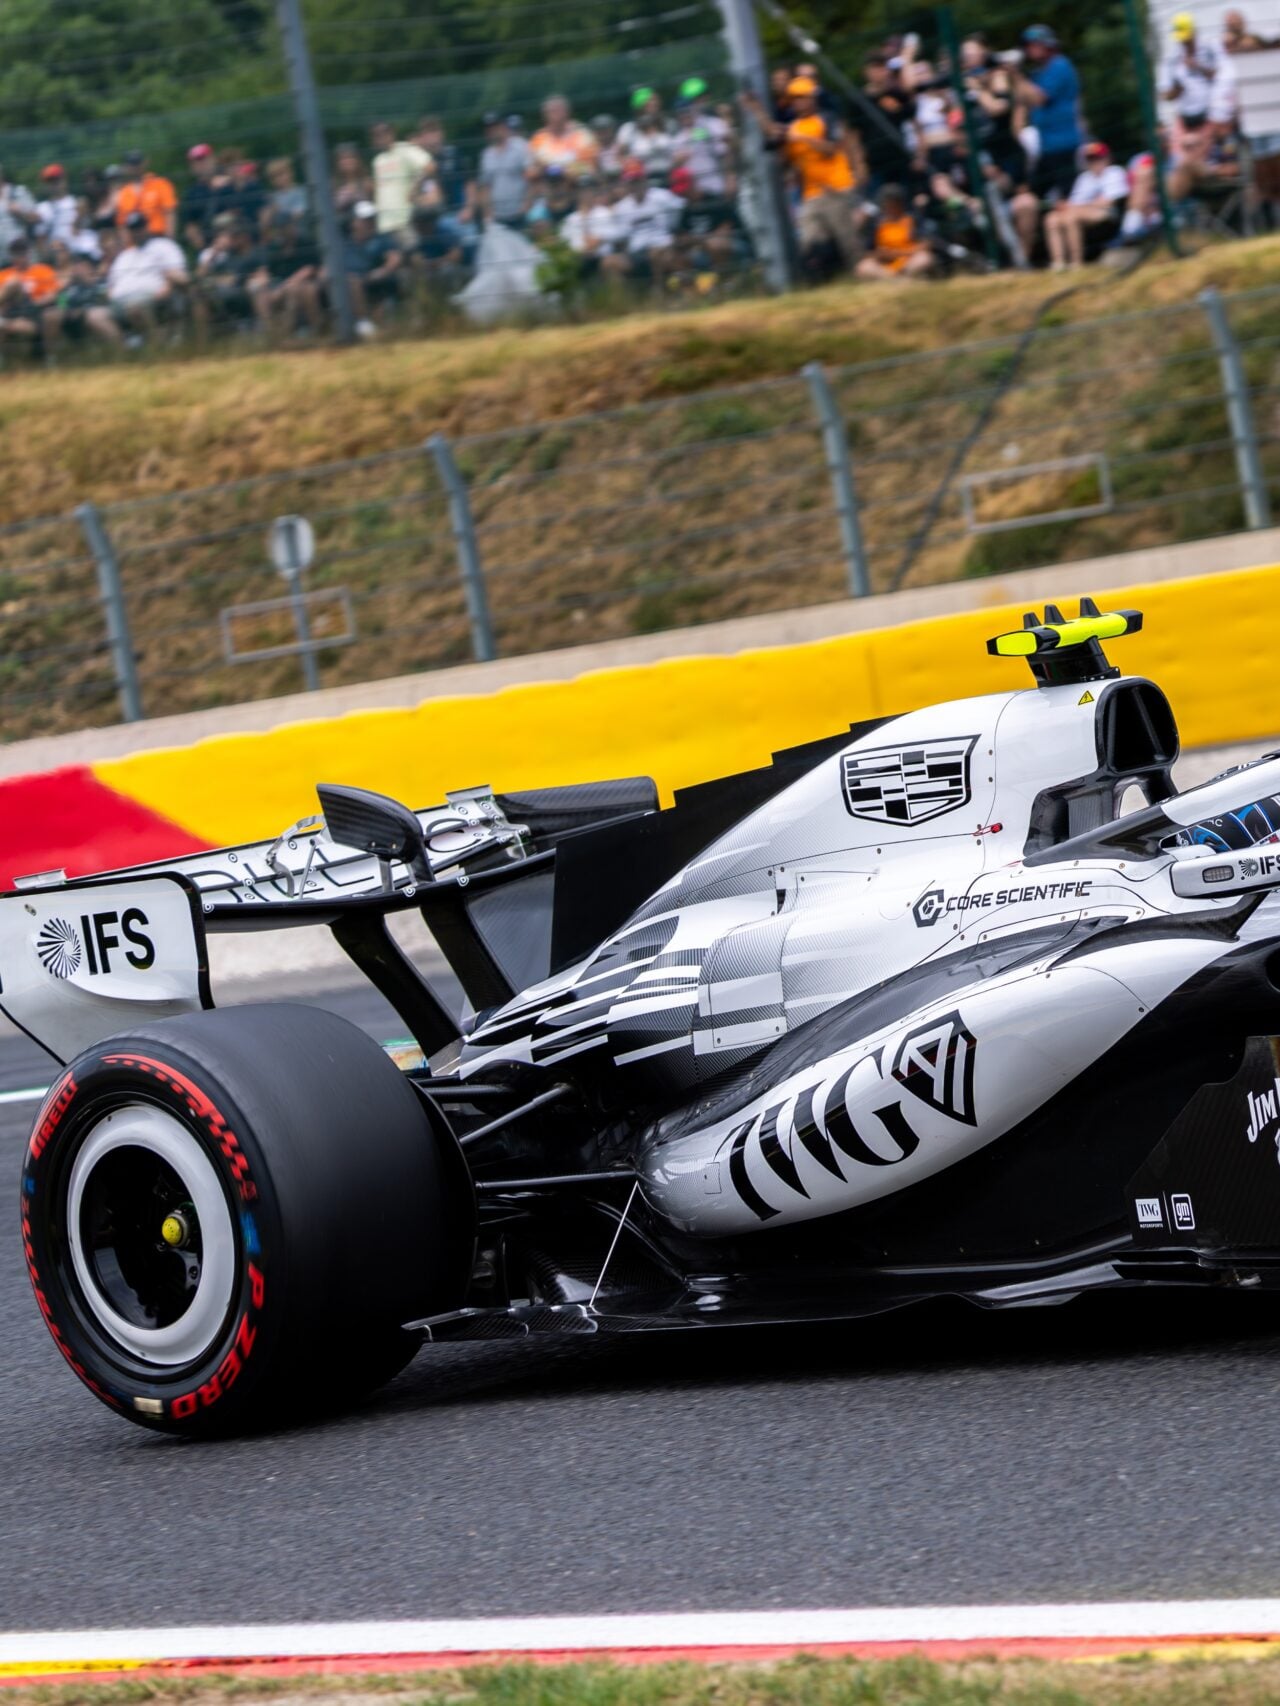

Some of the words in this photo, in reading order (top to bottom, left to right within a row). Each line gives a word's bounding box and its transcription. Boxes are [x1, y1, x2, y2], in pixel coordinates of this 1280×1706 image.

[945, 892, 993, 912] CORE
[996, 881, 1093, 905] SCIENTIFIC
[80, 908, 155, 975] IFS
[29, 1071, 78, 1161] PIRELLI
[1247, 1089, 1277, 1143] JIM
[1138, 1204, 1159, 1217] TWG
[248, 1262, 264, 1309] P
[171, 1311, 257, 1419] ZERO
